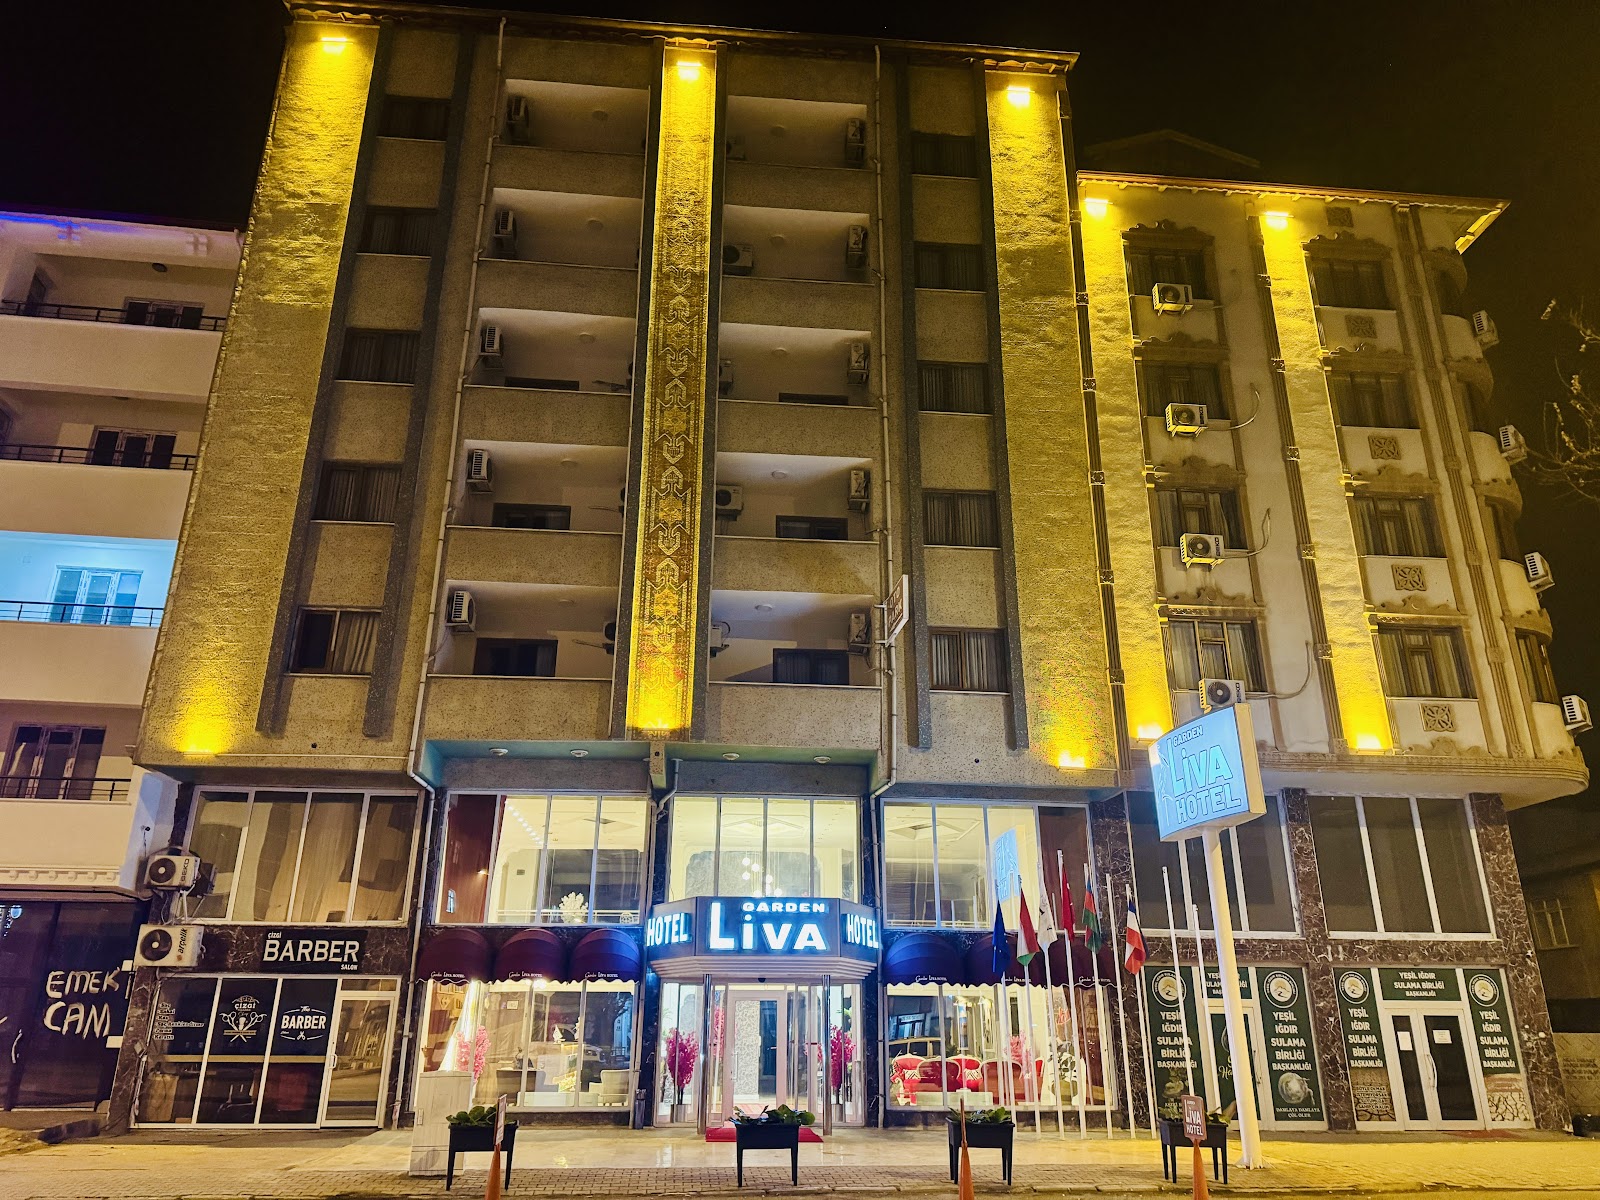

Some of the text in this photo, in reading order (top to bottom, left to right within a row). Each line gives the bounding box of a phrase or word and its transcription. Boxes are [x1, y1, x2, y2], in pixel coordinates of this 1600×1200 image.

[890, 586, 901, 608] OTO
[888, 598, 902, 628] PARK
[1173, 725, 1203, 747] GARDEN
[1176, 783, 1241, 824] HOTEL
[742, 902, 825, 912] GARDEN
[647, 913, 688, 947] HOTEL
[846, 914, 879, 949] HOTEL
[178, 927, 187, 954] arçelik
[263, 940, 359, 962] BARBER
[1399, 971, 1436, 980] YEŞİL IĞDIR
[46, 967, 120, 998] EMEK
[1422, 981, 1444, 989] BİRLİĞİ
[1160, 1010, 1181, 1021] YEŞİ
[1273, 1011, 1296, 1022] YEŞİL
[1348, 1007, 1369, 1019] YEŞİL
[1480, 1009, 1499, 1021] YEŞİL
[44, 1001, 110, 1039] CAM
[281, 1015, 326, 1029] BARBER
[1351, 1021, 1370, 1030] IĞDIR
[1275, 1024, 1298, 1034] IĞDIR
[1482, 1022, 1502, 1032] IĞDIR
[1271, 1038, 1306, 1047] SULAMA
[1348, 1035, 1378, 1044] SULAMA
[1480, 1036, 1509, 1045] SULAMA
[1161, 1048, 1190, 1058] BİRLİ
[1275, 1050, 1305, 1060] BİRLİĞİ
[1352, 1046, 1377, 1057] BİRLİĞİ
[1484, 1047, 1509, 1058] BİRLİĞİ
[1157, 1060, 1197, 1069] BAŞKANĞI
[1272, 1062, 1312, 1071] BAŞKANLIĞI
[1350, 1059, 1383, 1068] BAŞKANLIĞI
[1483, 1059, 1516, 1068] BAŞKANLIĞI
[1187, 1124, 1204, 1136] HOTEL
